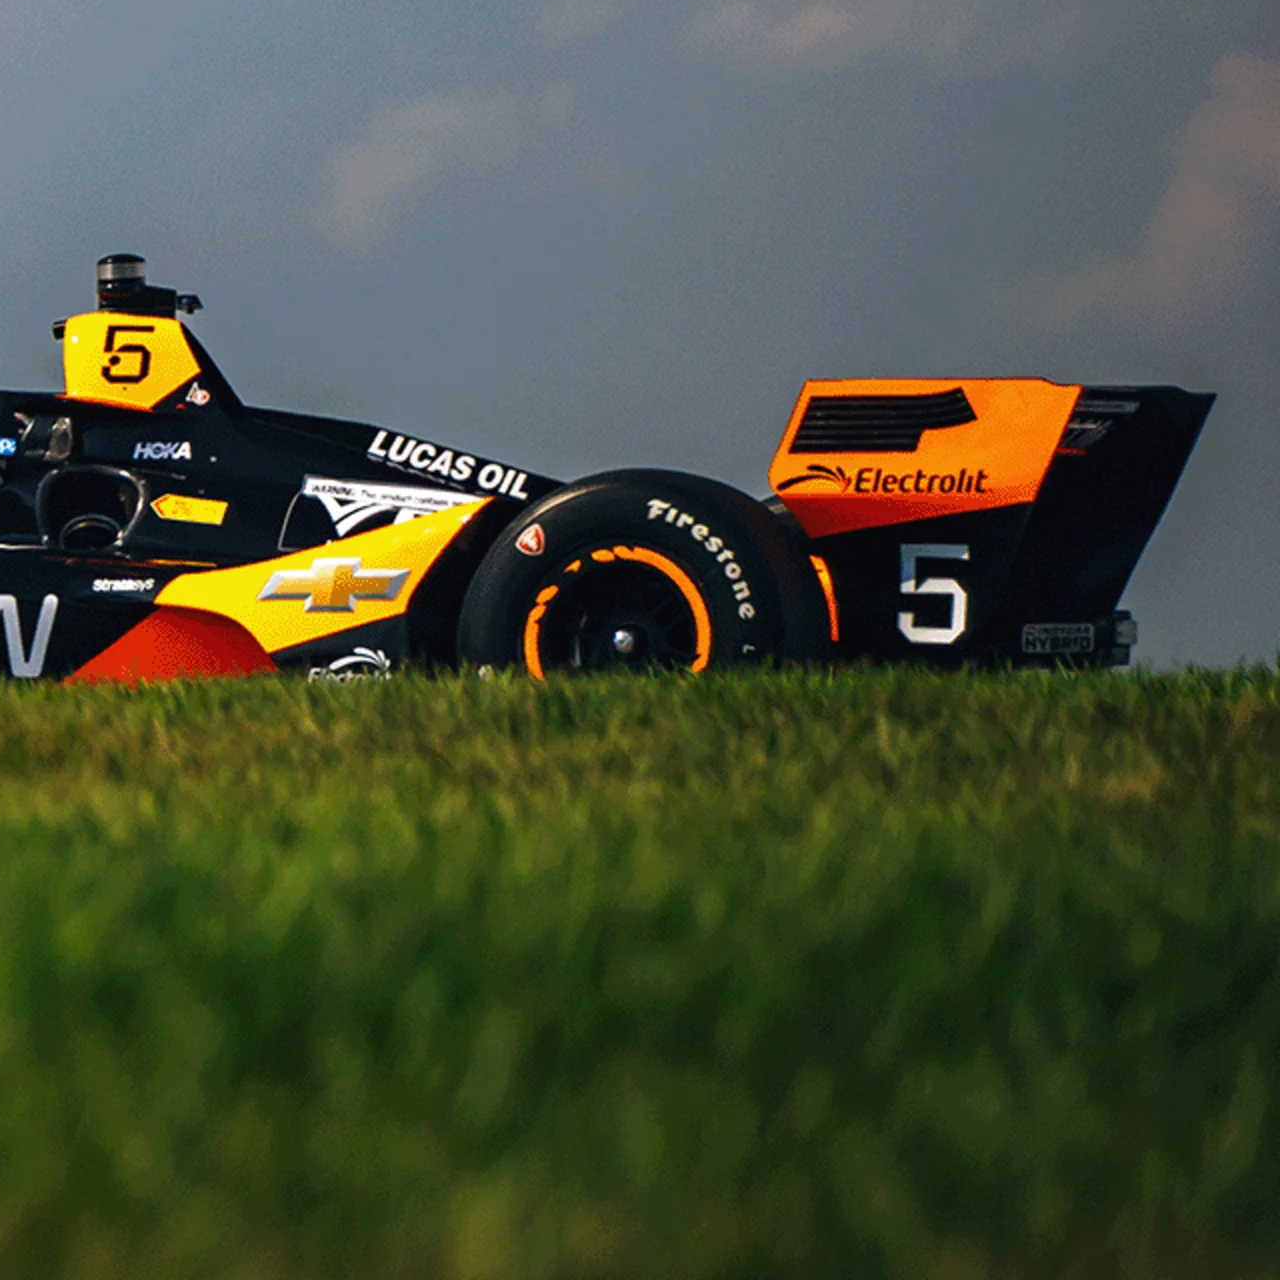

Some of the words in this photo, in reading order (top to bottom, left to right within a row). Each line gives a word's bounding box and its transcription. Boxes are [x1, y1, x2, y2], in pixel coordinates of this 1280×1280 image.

[101, 325, 155, 384] 5
[133, 441, 191, 459] HOKA
[367, 430, 477, 481] LUCAS
[478, 463, 529, 501] OIL
[855, 468, 988, 493] Electrolit
[647, 499, 756, 620] Firestone
[896, 544, 970, 644] 5
